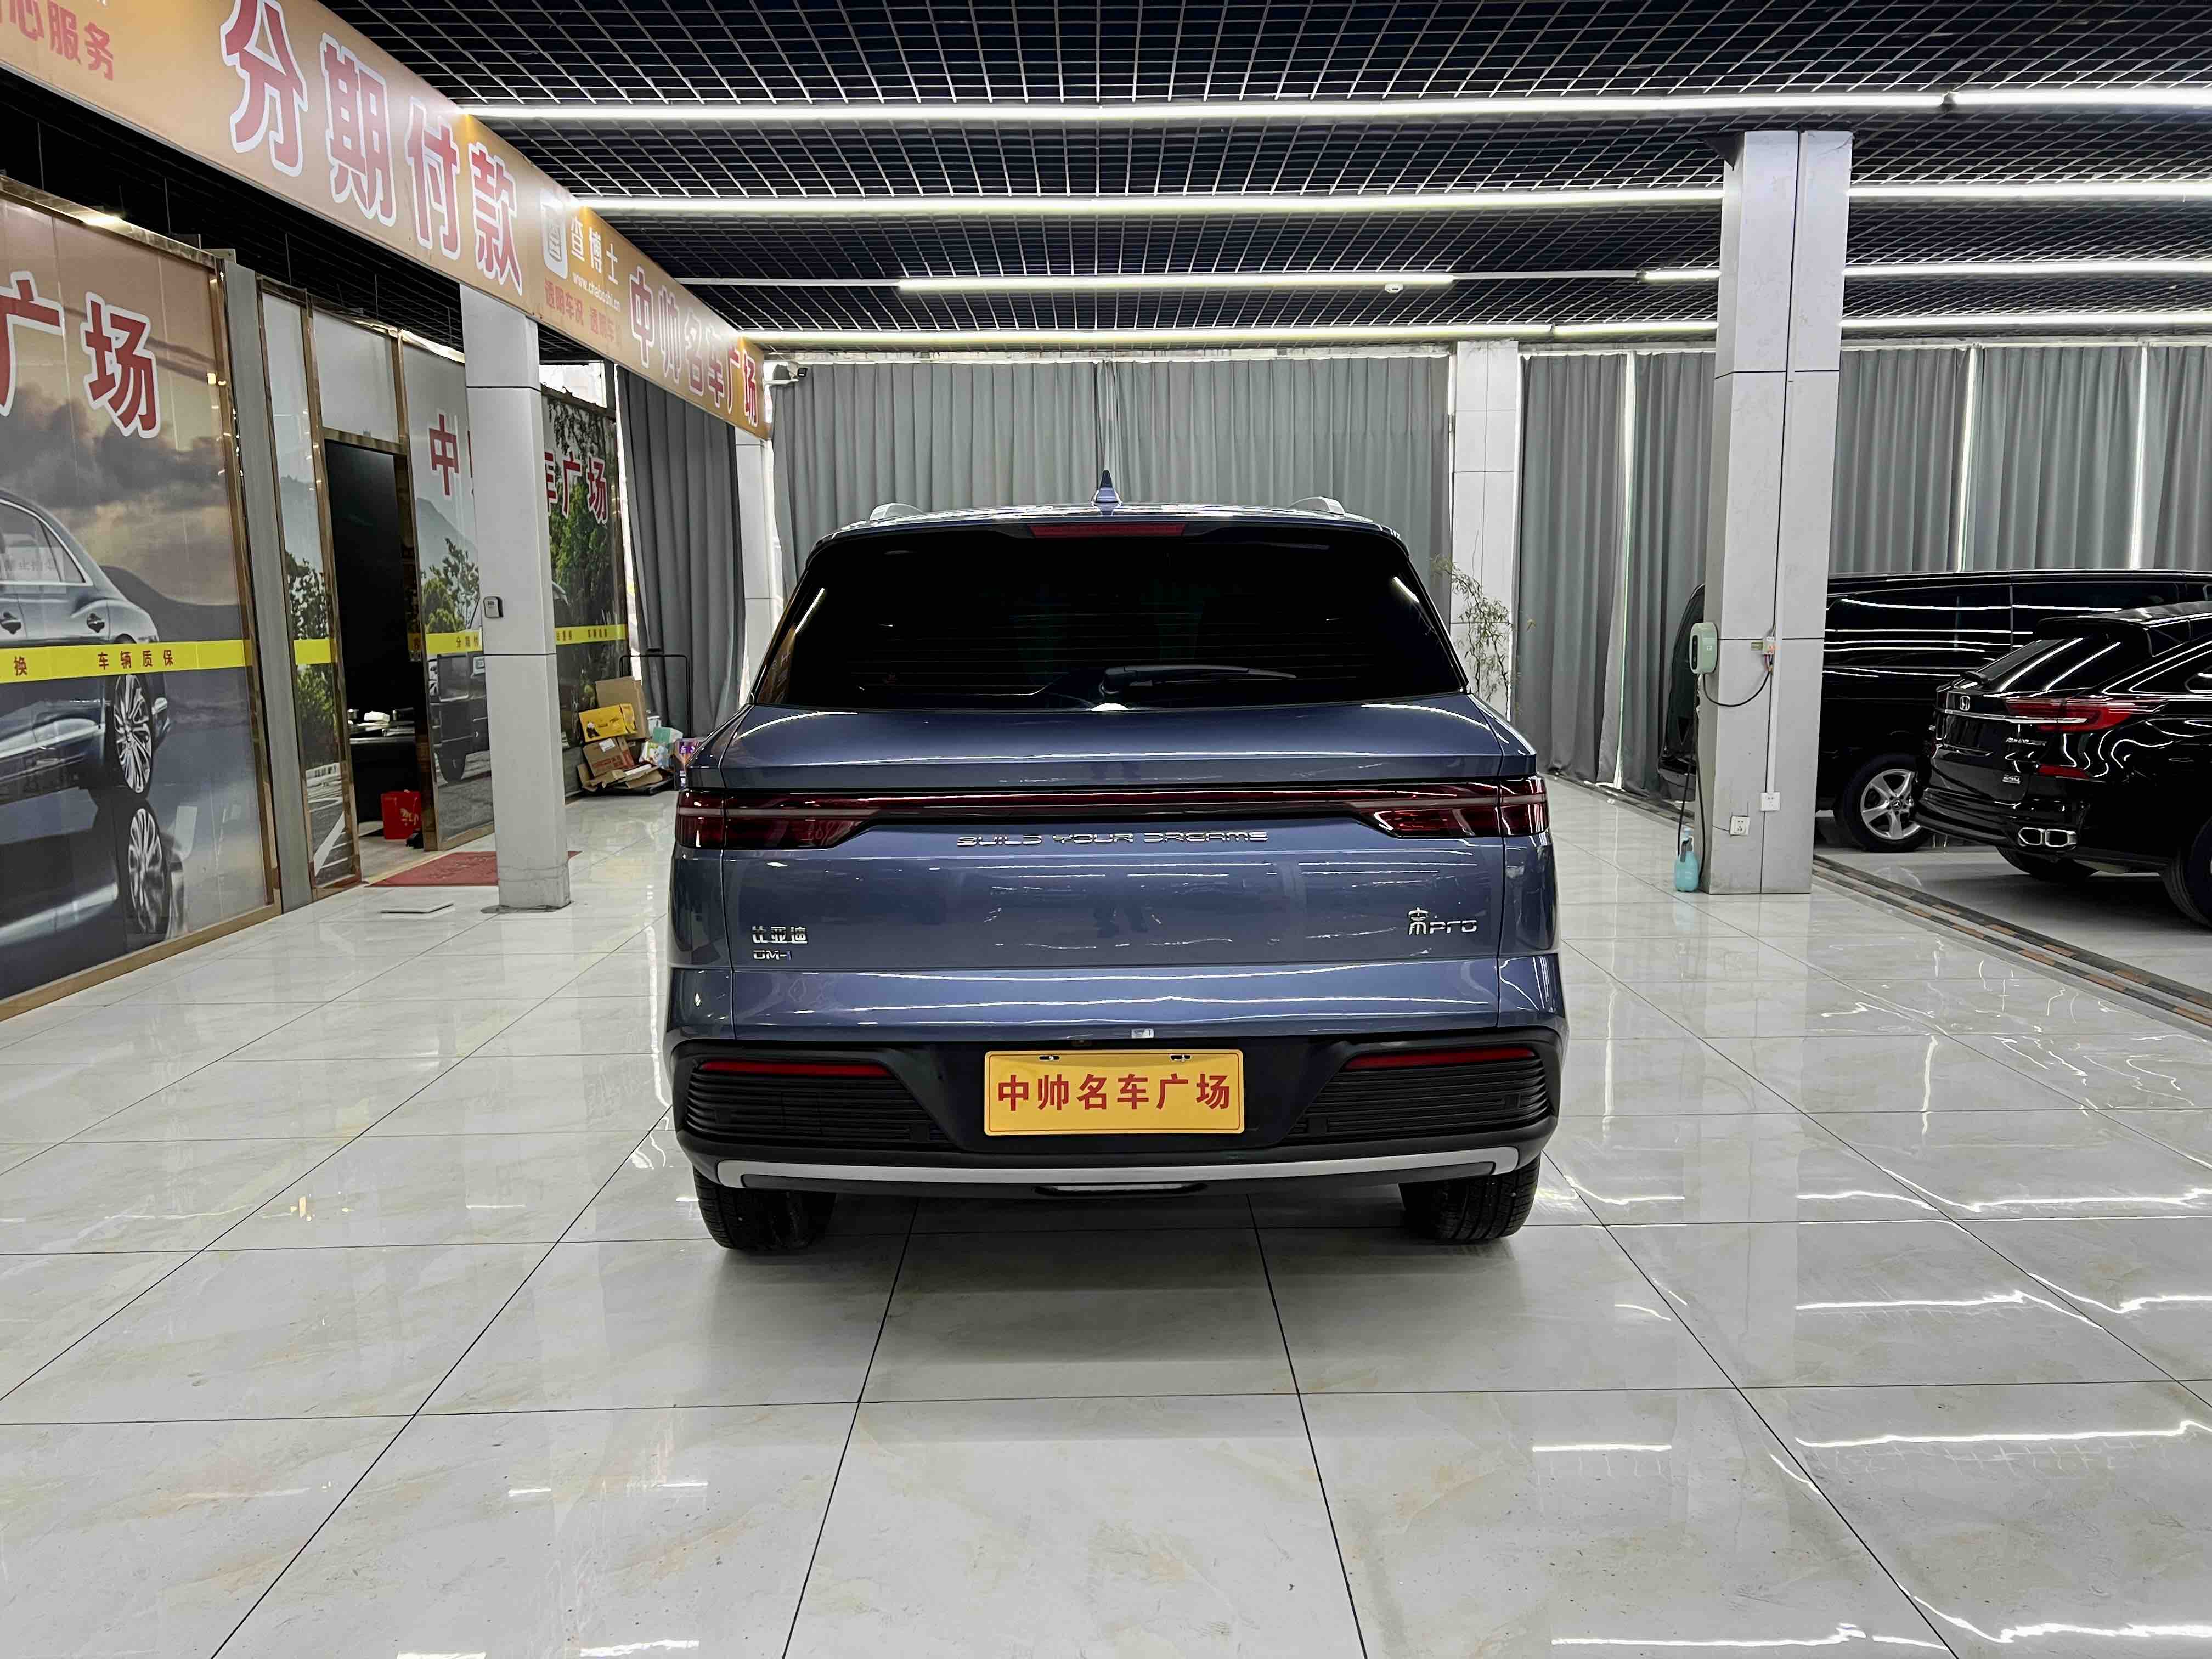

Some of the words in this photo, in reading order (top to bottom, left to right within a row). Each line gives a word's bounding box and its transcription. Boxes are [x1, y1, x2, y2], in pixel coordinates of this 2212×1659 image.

[0, 0, 114, 81] 心服务
[221, 0, 522, 296] 分期付款
[571, 216, 618, 285] 查博士
[0, 271, 160, 438] 广场
[630, 265, 758, 427] 中帅名车广场
[428, 413, 474, 498] 中
[98, 649, 174, 671] 车辆质保
[956, 834, 1042, 847] BUILD
[1052, 833, 1134, 845] YOUR
[1143, 831, 1269, 843] DREAMS
[752, 925, 808, 944] 比亚迪
[997, 1073, 1229, 1112] 中帅名车广场
